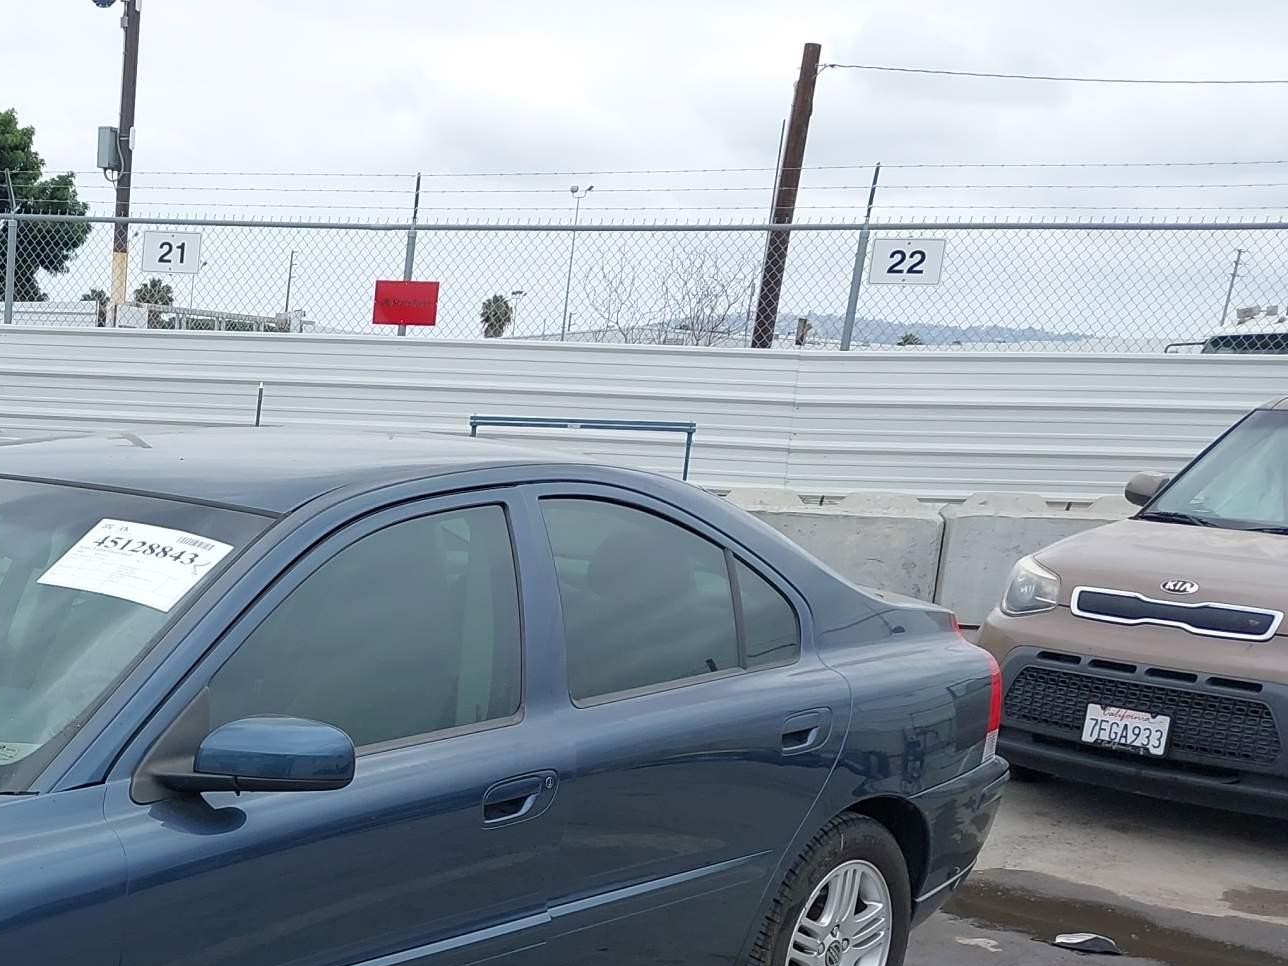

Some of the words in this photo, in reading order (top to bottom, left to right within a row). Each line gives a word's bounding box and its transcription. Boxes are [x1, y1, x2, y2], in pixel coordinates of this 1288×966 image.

[157, 241, 186, 264] 21
[886, 249, 927, 274] 22
[93, 535, 200, 566] 45128843
[1165, 580, 1196, 592] KIA
[1088, 717, 1163, 750] 7FGA933
